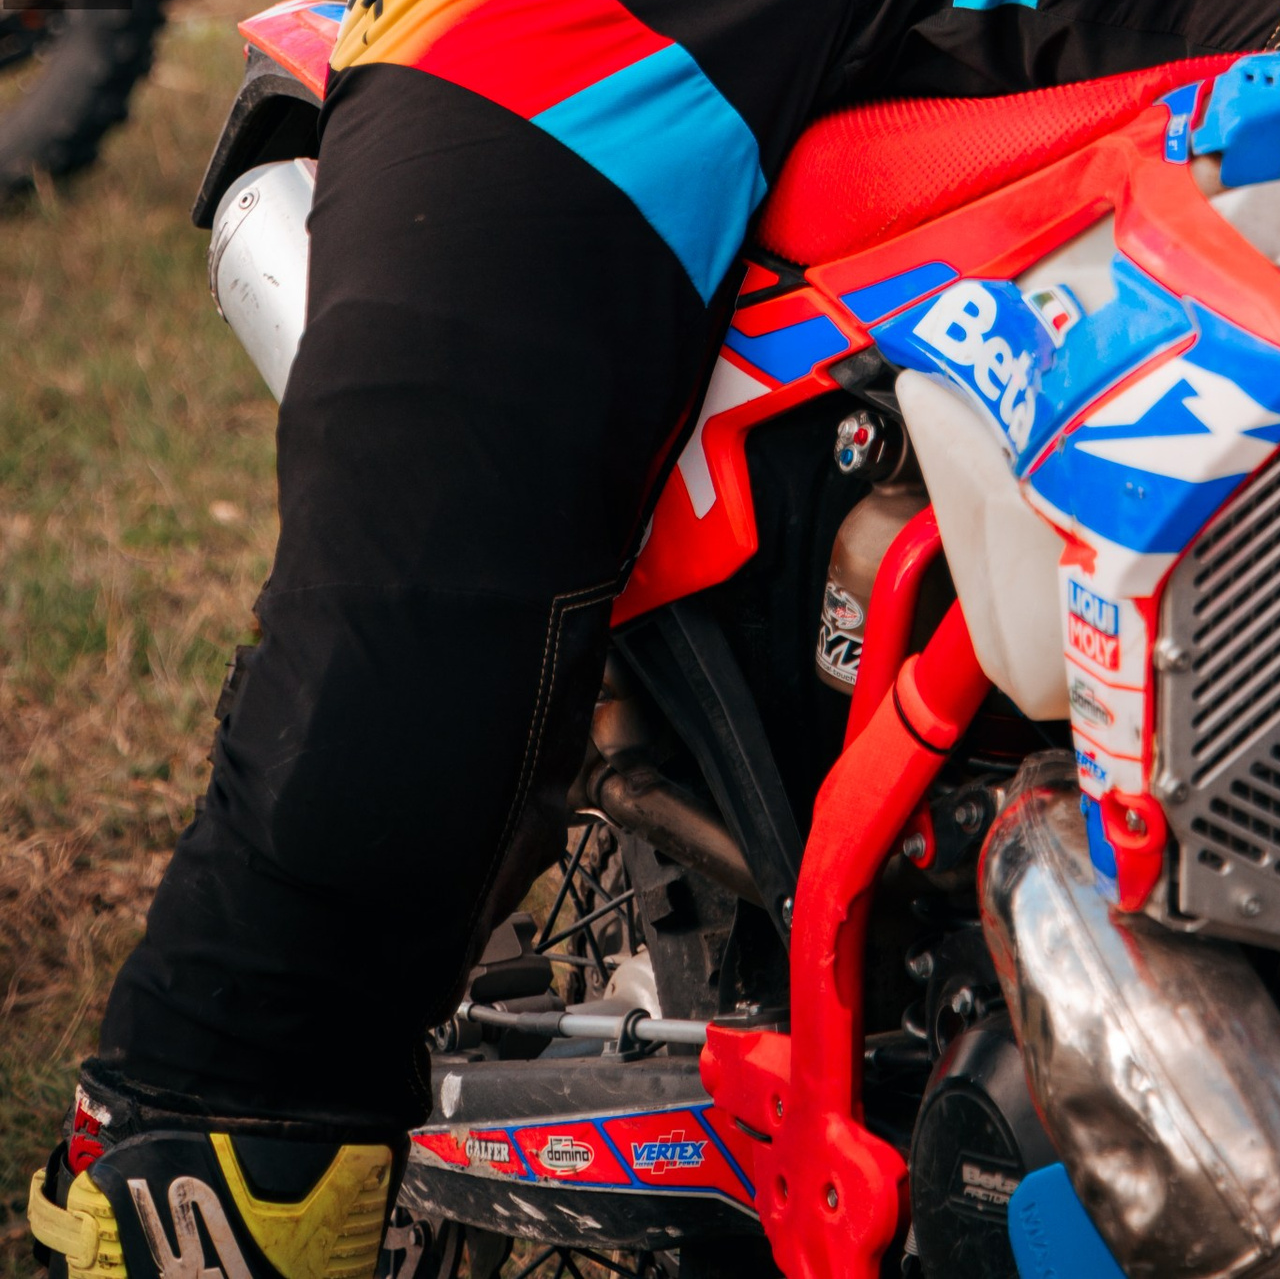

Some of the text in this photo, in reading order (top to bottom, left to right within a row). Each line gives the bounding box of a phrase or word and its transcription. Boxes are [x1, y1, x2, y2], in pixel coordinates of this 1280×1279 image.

[912, 280, 1036, 455] Beta
[1069, 582, 1119, 636] LIQUI
[1069, 613, 1119, 672] MOLY
[465, 1139, 509, 1162] GALFER
[546, 1138, 591, 1162] domino
[632, 1141, 705, 1161] VERTEX
